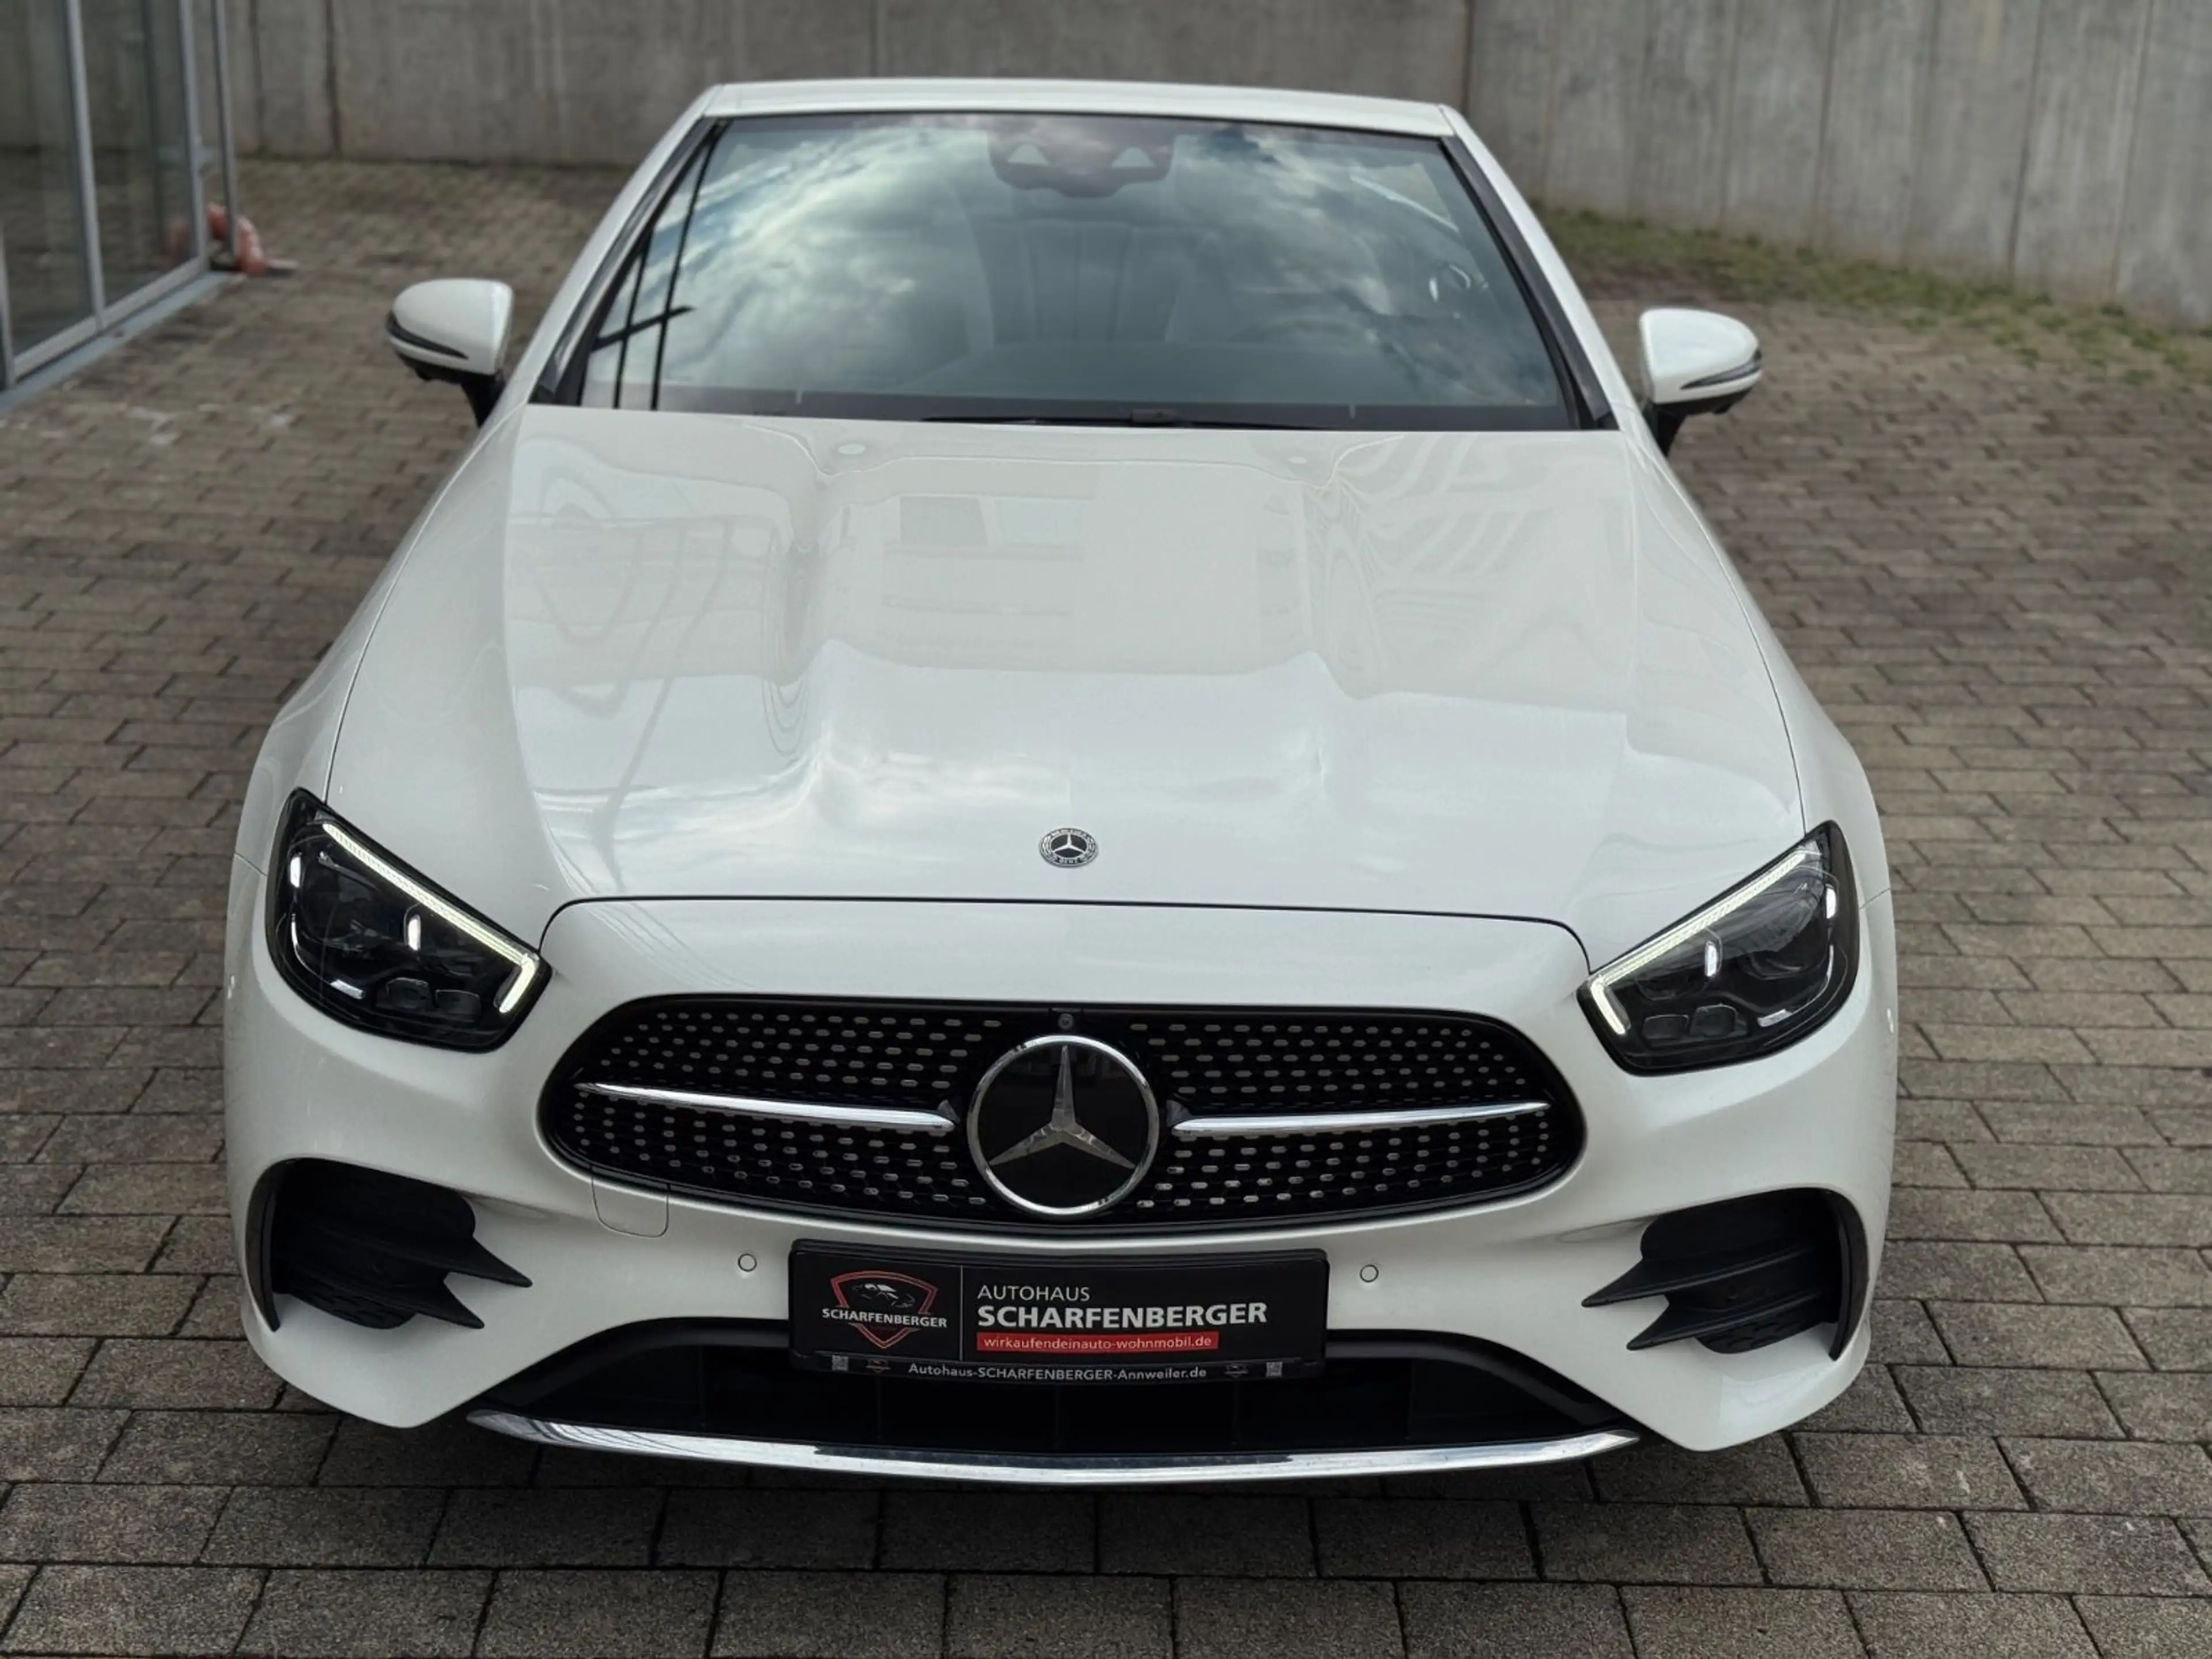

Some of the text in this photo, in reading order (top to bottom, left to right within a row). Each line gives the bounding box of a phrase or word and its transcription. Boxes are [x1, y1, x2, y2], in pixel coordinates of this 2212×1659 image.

[977, 1285, 1090, 1302] AUTOHAUS
[822, 1308, 948, 1328] SCHARFENBERGER
[978, 1301, 1267, 1328] SCHARFENBERGER
[984, 1335, 1213, 1350] wirkaufendeinauto-wohnmobil.de
[908, 1363, 1207, 1381] Autohaus-SCHARFENBERGER-Annweiler.de
